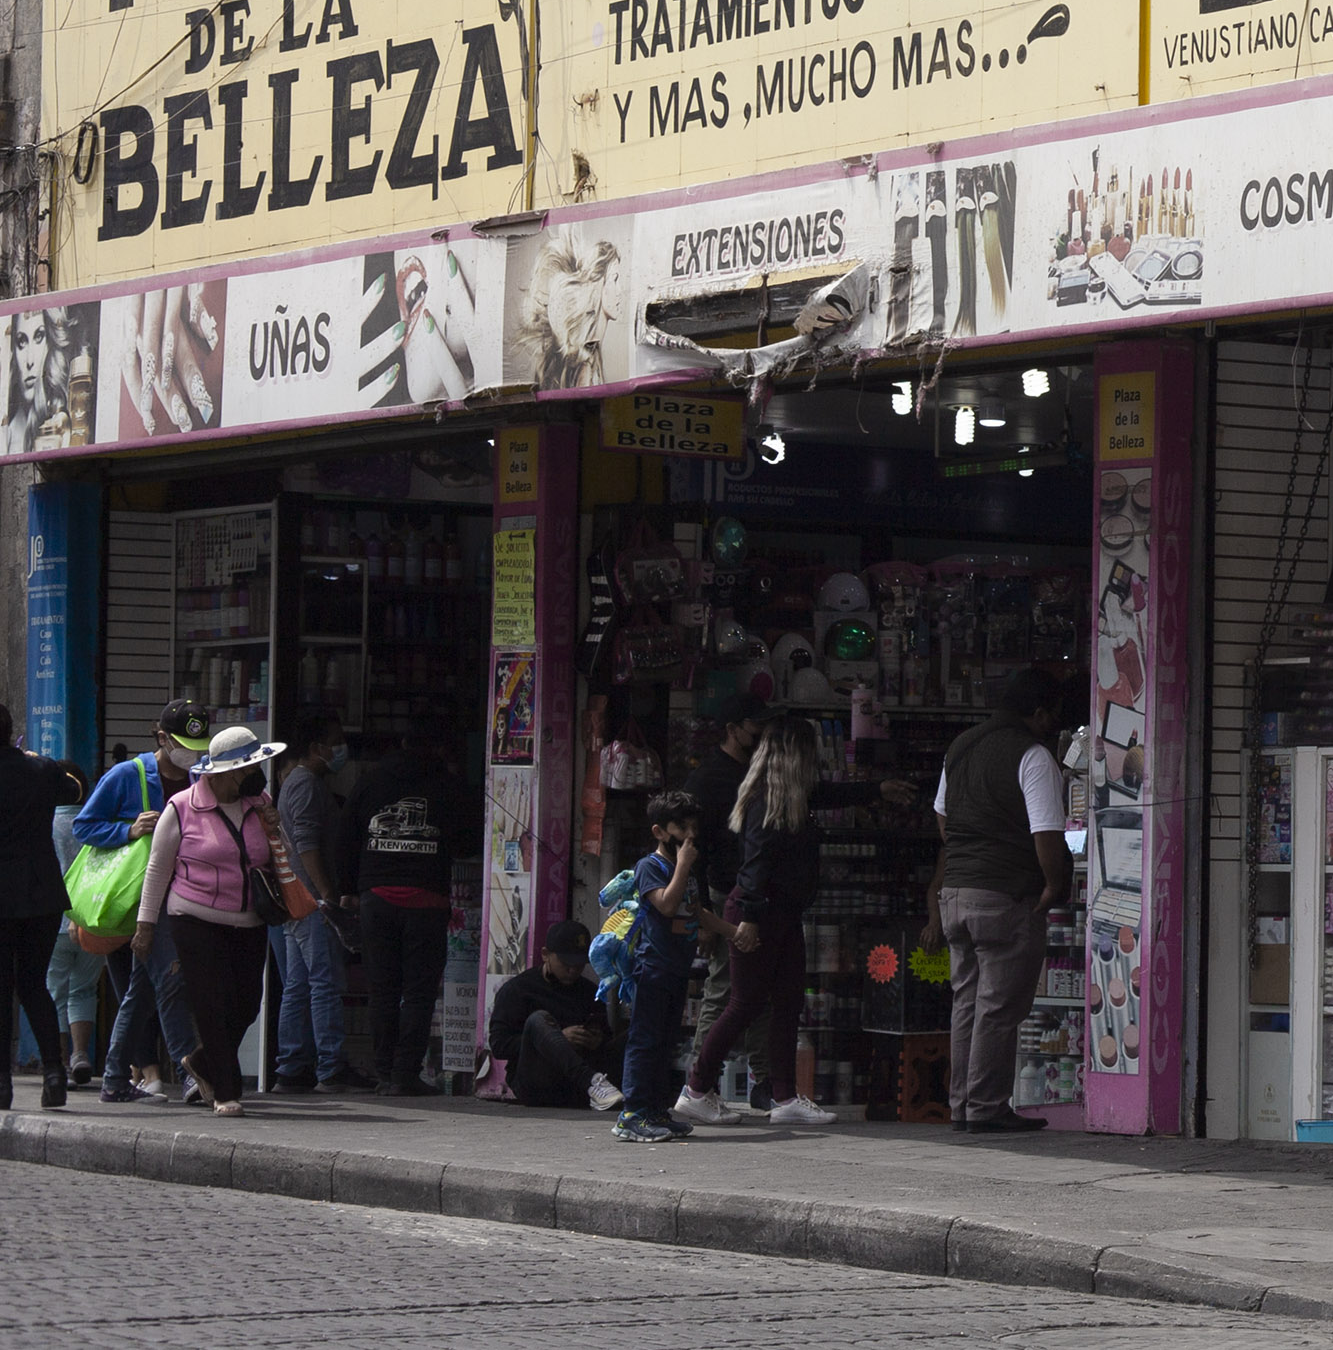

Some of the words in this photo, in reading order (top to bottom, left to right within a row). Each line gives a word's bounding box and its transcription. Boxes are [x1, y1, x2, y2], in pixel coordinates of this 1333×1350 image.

[185, 0, 253, 74] DE
[1164, 11, 1298, 69] VENUSTIANO
[614, 89, 633, 142] Y
[98, 23, 524, 241] BELLEZA
[672, 209, 845, 278] EXTENSIONES
[248, 305, 331, 381] UÑAS
[634, 396, 714, 417] Plaza
[1114, 389, 1141, 403] Plaza
[636, 414, 679, 431] de
[685, 418, 710, 435] la
[1115, 412, 1128, 426] de
[1130, 411, 1139, 425] la
[509, 442, 528, 452] Plaza
[618, 432, 729, 455] Belleza
[1109, 434, 1145, 450] Belleza
[510, 461, 519, 473] de
[521, 460, 527, 472] la
[505, 481, 532, 493] Belleza
[746, 496, 758, 505] SU
[760, 497, 795, 506] CABELLO
[380, 841, 436, 851] KENWORTH
